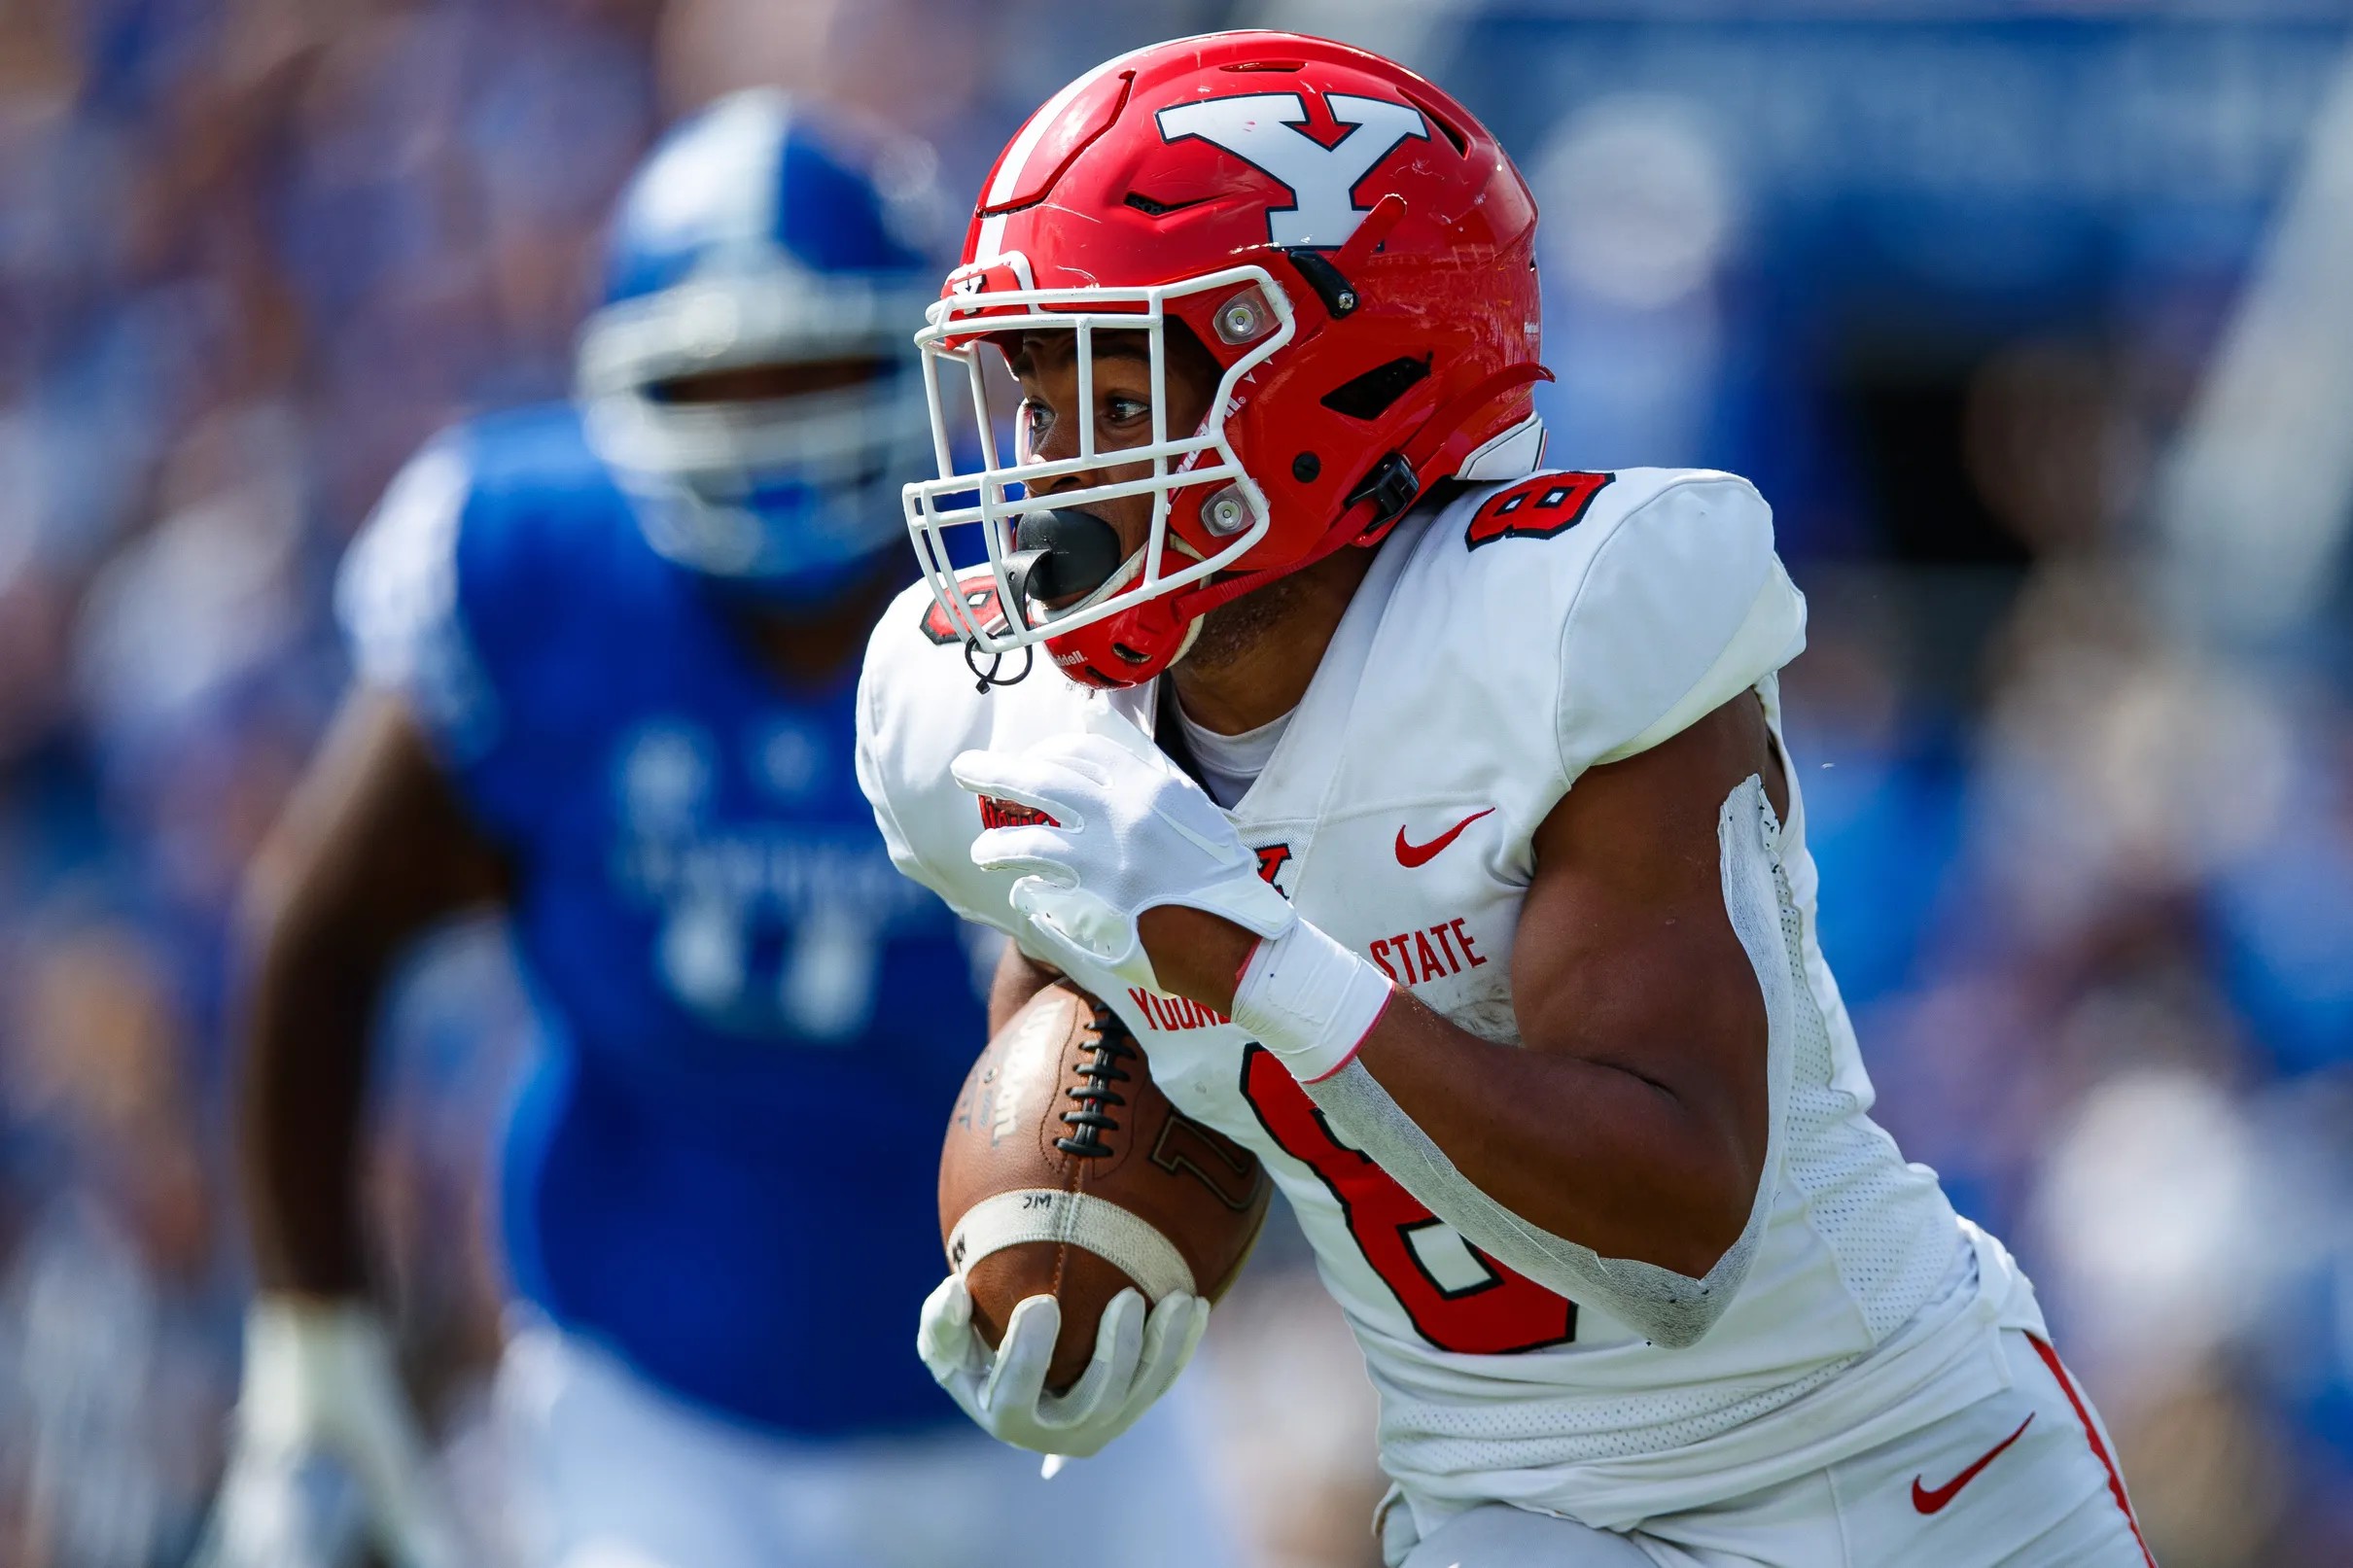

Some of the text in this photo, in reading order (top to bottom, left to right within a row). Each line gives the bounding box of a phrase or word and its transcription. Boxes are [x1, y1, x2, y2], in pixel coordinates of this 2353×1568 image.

[1154, 91, 1431, 253] Y
[1464, 470, 1616, 552] 8
[1369, 917, 1488, 988] STATE
